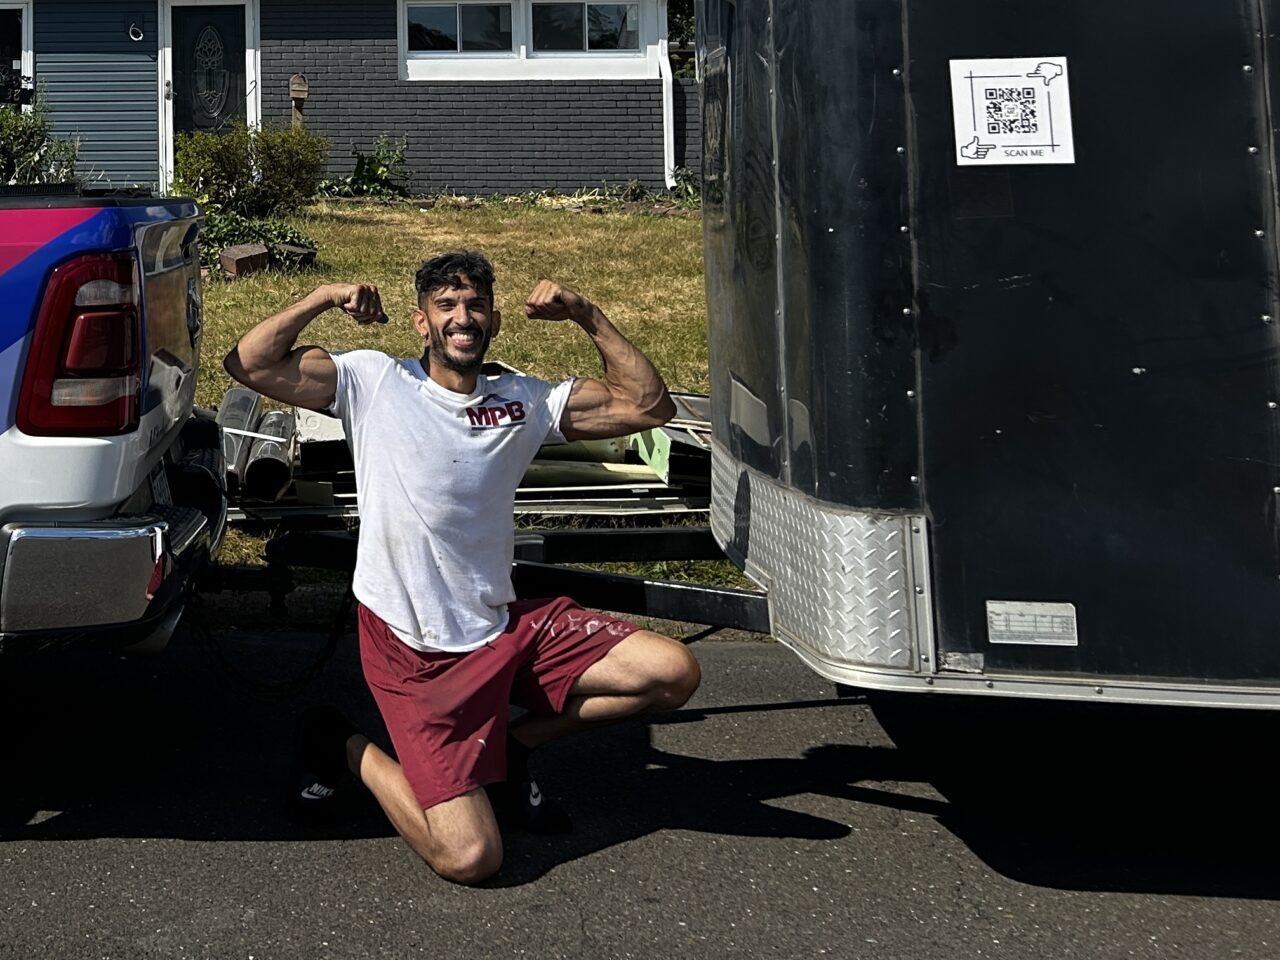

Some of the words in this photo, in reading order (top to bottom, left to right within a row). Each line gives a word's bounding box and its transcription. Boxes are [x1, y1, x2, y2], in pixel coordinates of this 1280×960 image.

[1004, 149, 1028, 157] SCAN
[1030, 149, 1044, 157] ME
[465, 400, 526, 427] MPB
